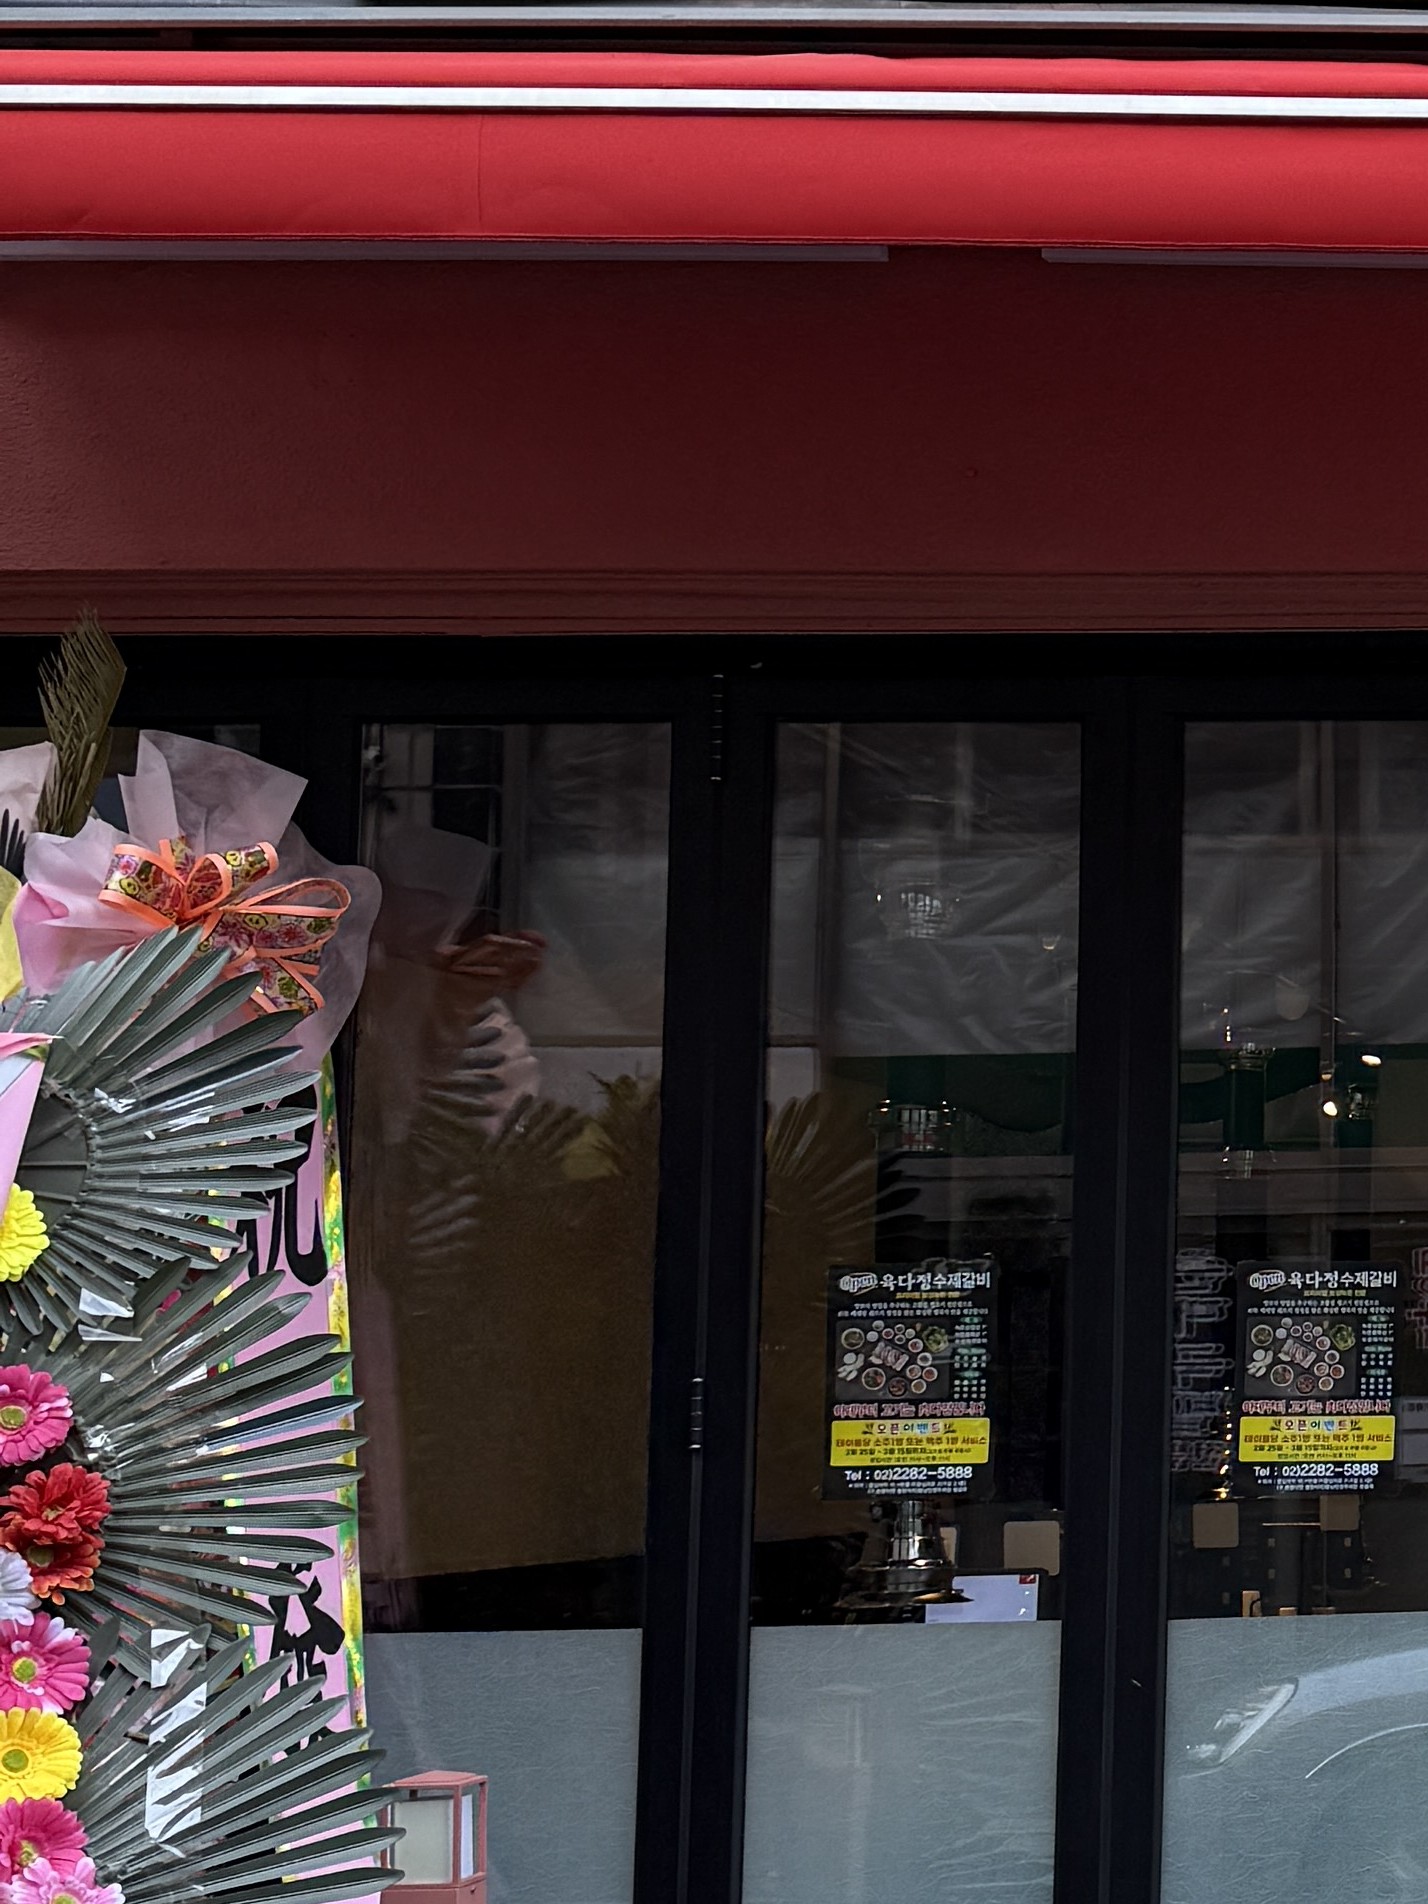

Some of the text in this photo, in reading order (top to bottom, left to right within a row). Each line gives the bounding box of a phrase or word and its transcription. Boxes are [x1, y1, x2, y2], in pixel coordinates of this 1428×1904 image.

[845, 1470, 862, 1481] Tel
[874, 1466, 973, 1481] 02)2282-5888
[1253, 1466, 1271, 1477] Tel
[1282, 1463, 1379, 1477] 02)2282-5888
